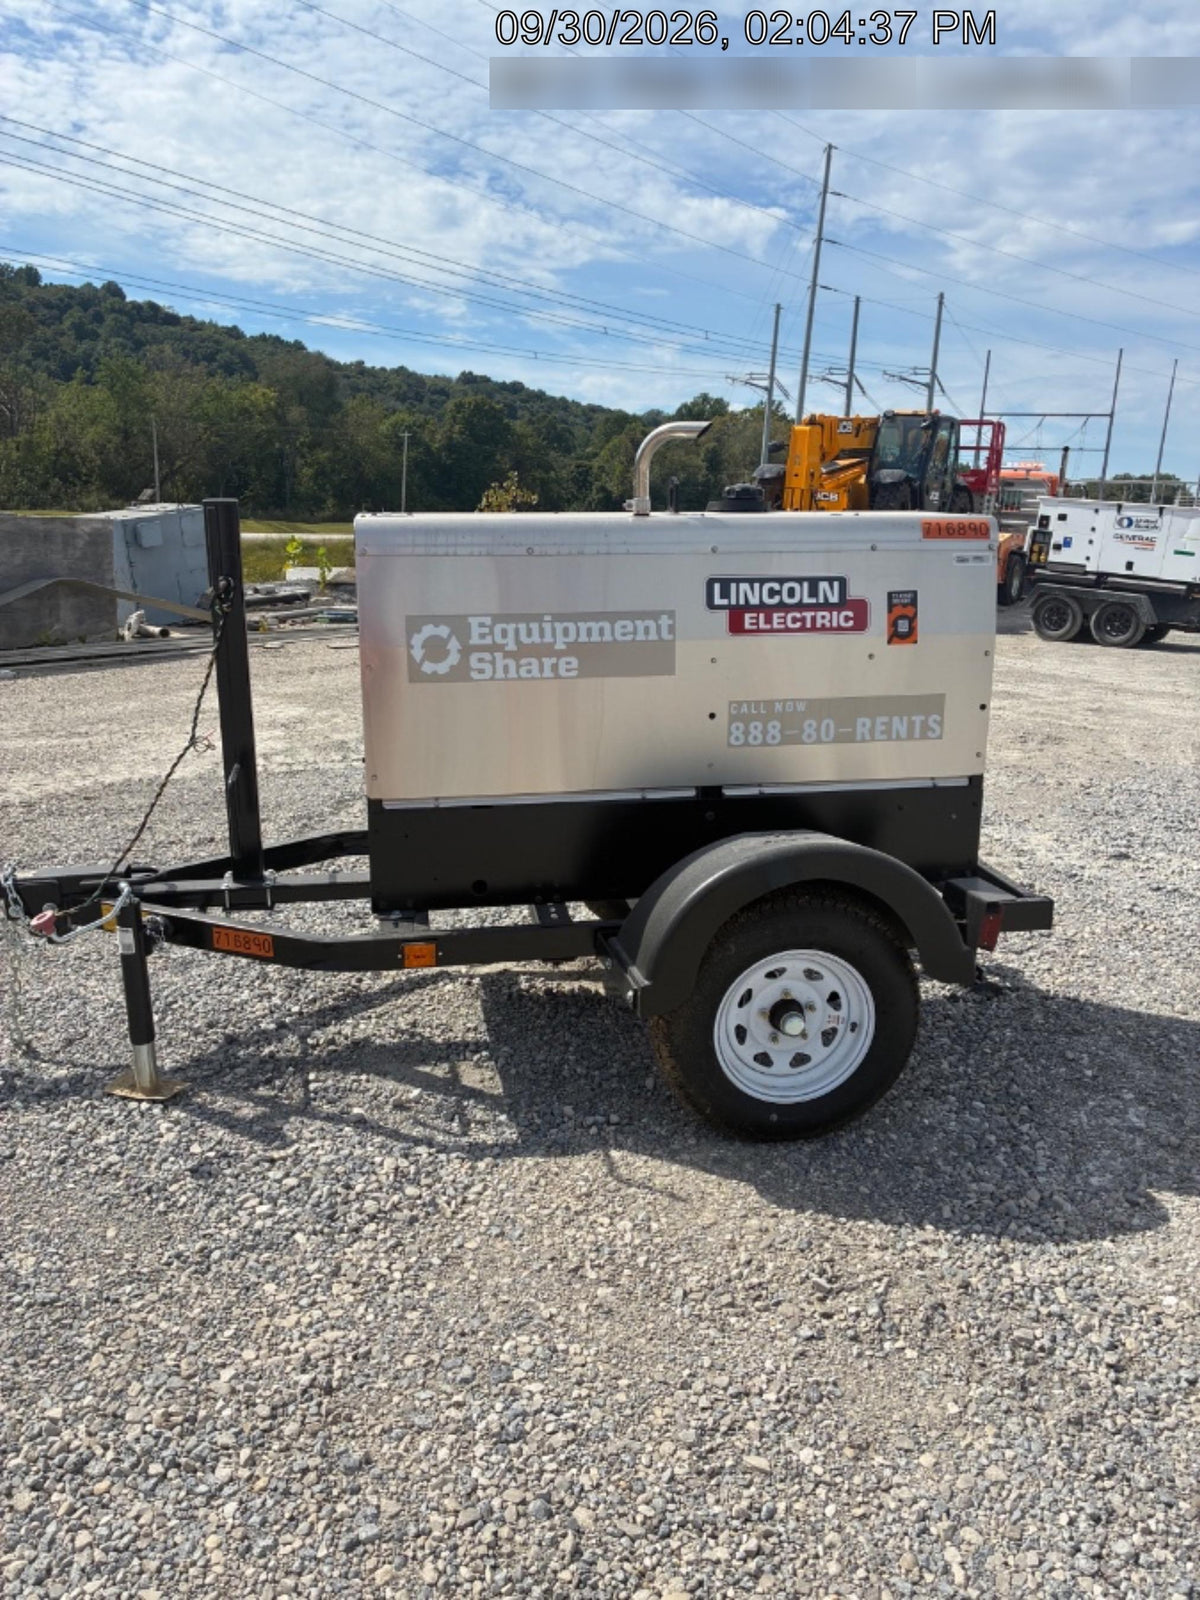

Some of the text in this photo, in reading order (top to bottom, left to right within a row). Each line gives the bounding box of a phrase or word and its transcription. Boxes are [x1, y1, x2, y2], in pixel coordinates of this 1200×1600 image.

[922, 521, 990, 537] 716890
[713, 580, 840, 606] LINCOLN
[468, 613, 674, 651] Equipment
[743, 610, 855, 631] ELECTRIC
[468, 651, 580, 681] Share
[729, 700, 808, 715] CALL NOW
[729, 714, 942, 746] 888-80-RENTS
[214, 930, 271, 953] 716890
